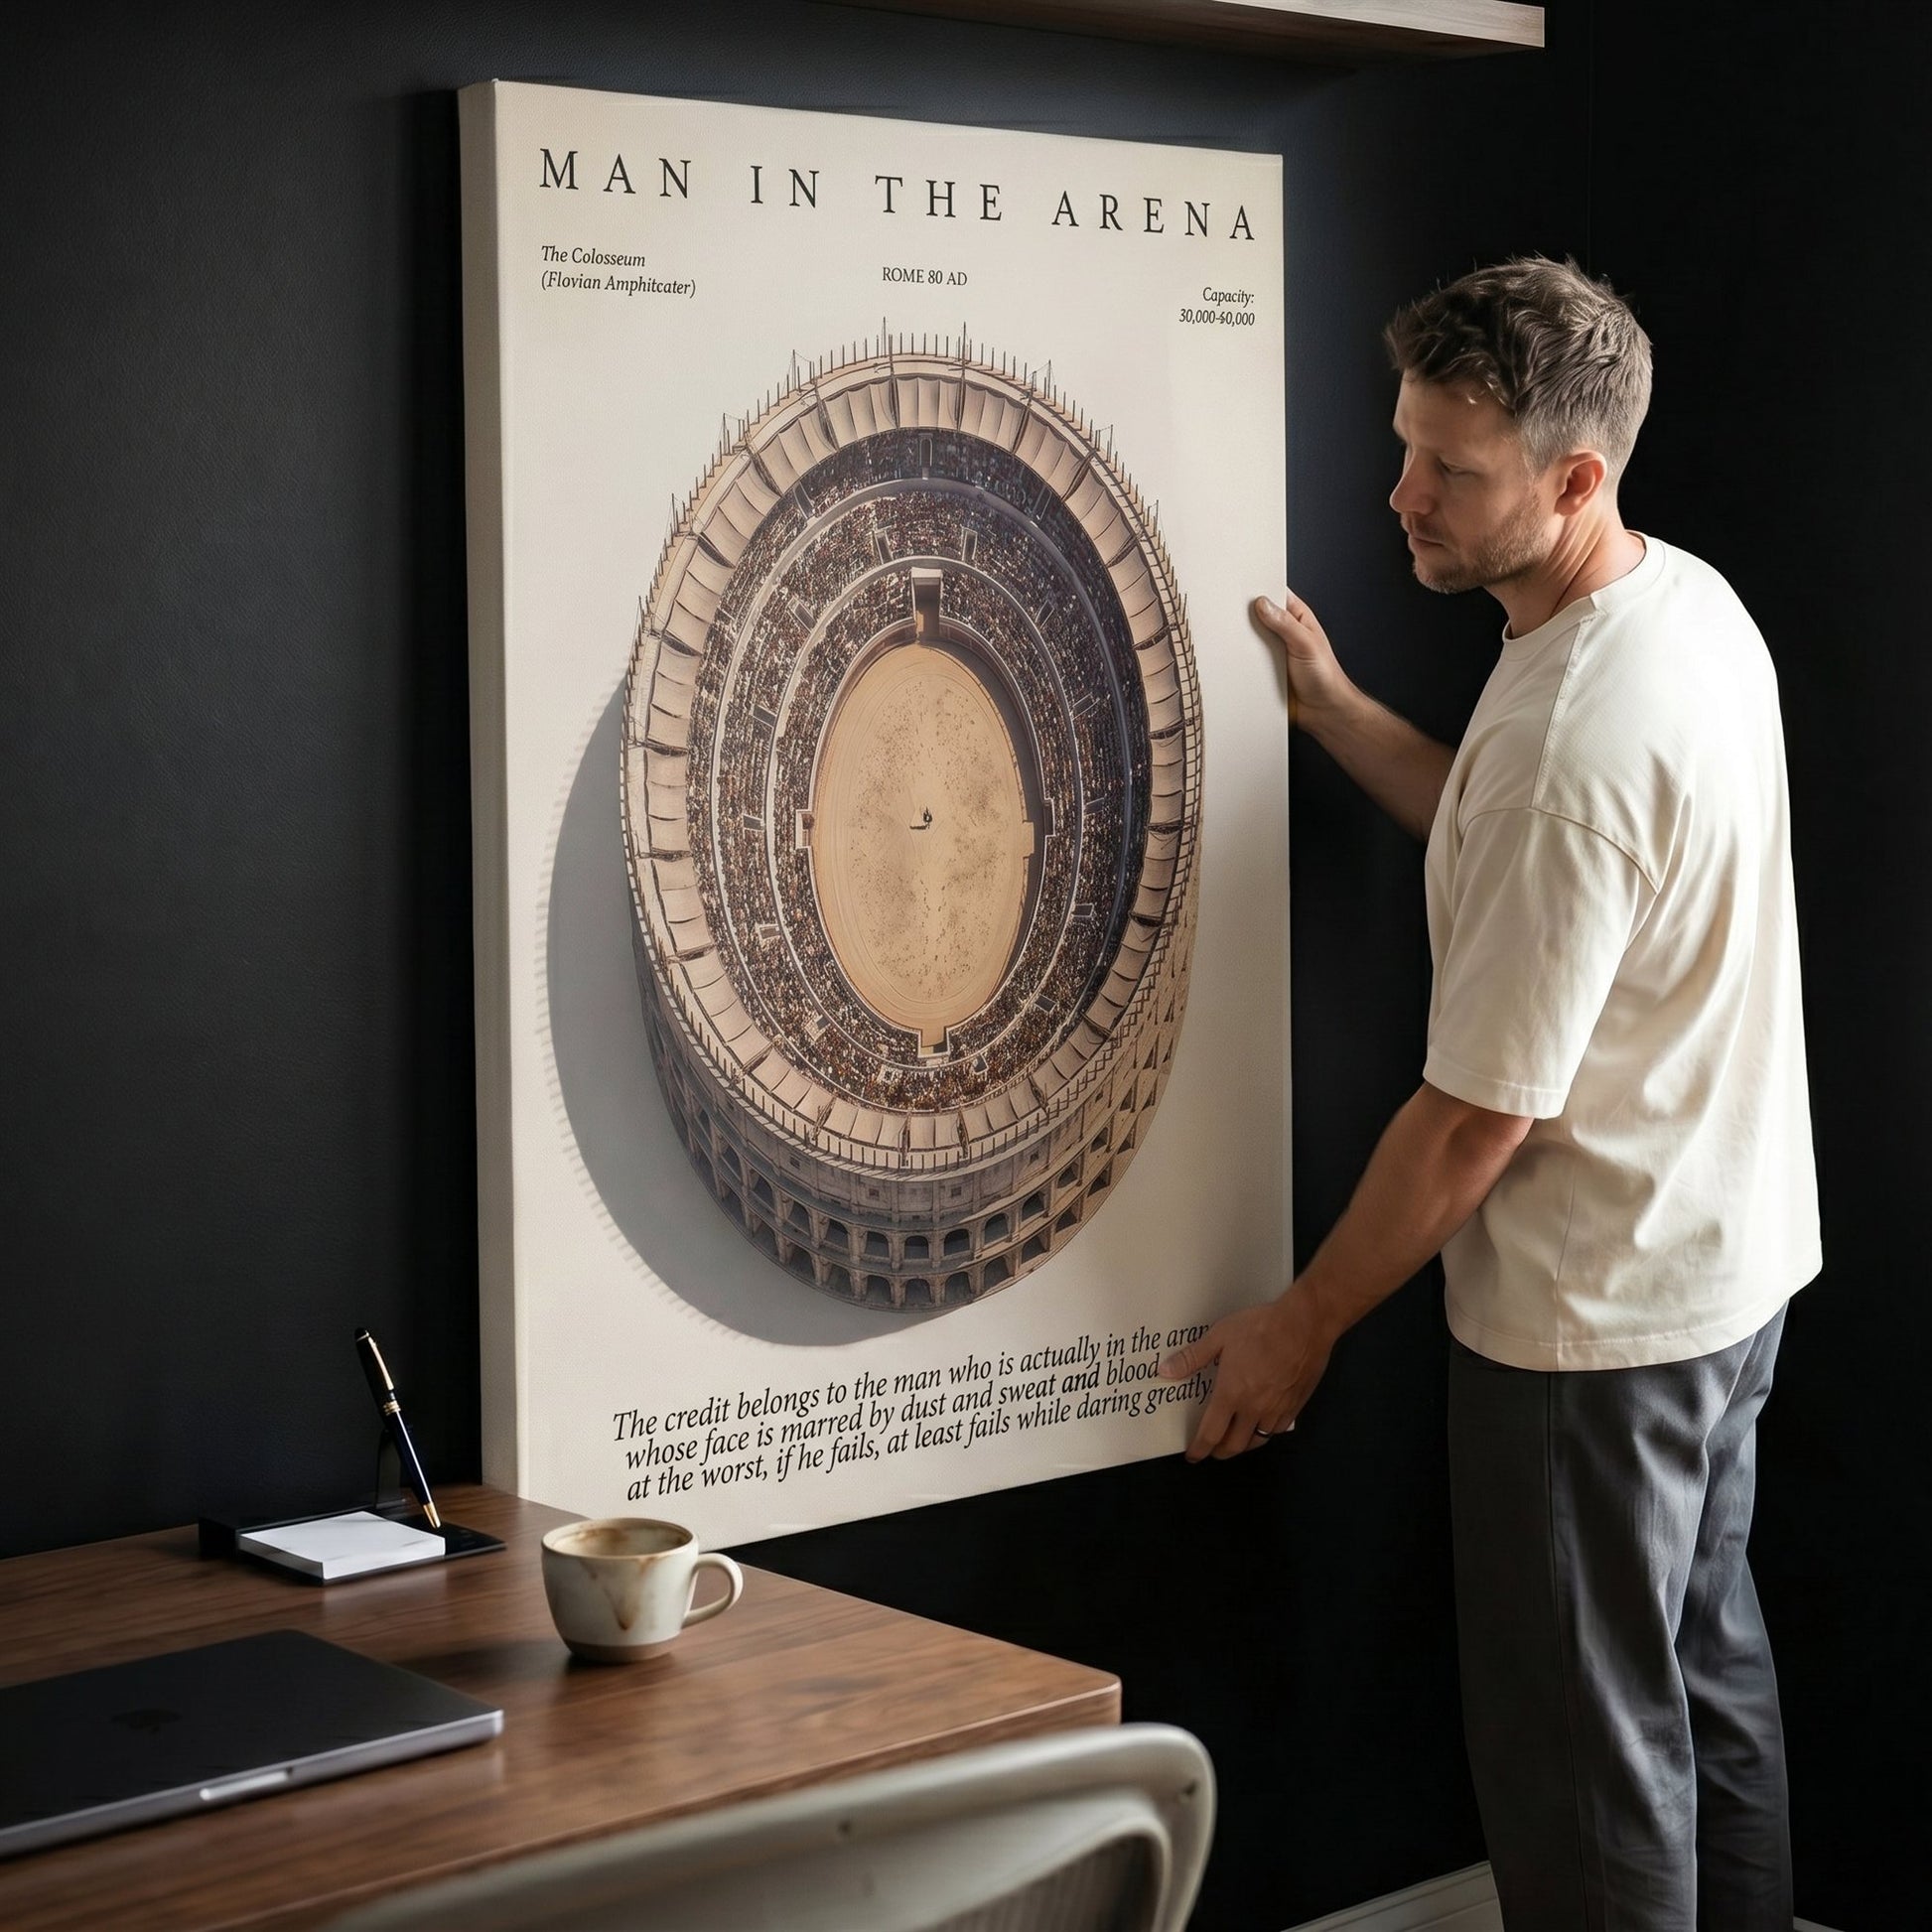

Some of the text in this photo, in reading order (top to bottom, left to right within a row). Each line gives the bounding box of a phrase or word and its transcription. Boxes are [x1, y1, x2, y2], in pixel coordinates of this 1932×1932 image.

[539, 147, 1255, 241] MAN IN THE ARENA
[540, 269, 602, 291] (Flovian
[541, 244, 645, 268] The Colosseum
[882, 266, 968, 287] ROME 80 AD
[1202, 286, 1255, 309] Capacity:
[613, 1408, 658, 1442] The
[664, 1396, 732, 1433] credit
[737, 1386, 821, 1420] belongs
[826, 1381, 848, 1406] to
[854, 1370, 889, 1401] the
[894, 1368, 942, 1395] man
[947, 1353, 993, 1385] who
[998, 1350, 1015, 1378] is
[1020, 1334, 1102, 1373] actually
[1106, 1334, 1126, 1358] in
[1131, 1325, 1162, 1354] the
[624, 1351, 1161, 1471] whose face is marred by dust and sweat and blood
[626, 1472, 652, 1503] at
[657, 1464, 695, 1497] the
[700, 1452, 769, 1489] worst,
[776, 1444, 798, 1483] if
[797, 1442, 825, 1472] he
[825, 1430, 882, 1475] fails,
[887, 1427, 910, 1455] at
[914, 1420, 964, 1450] least
[963, 1407, 1012, 1449] fails
[1016, 1397, 1072, 1432] while
[1076, 1387, 1143, 1420] daring
